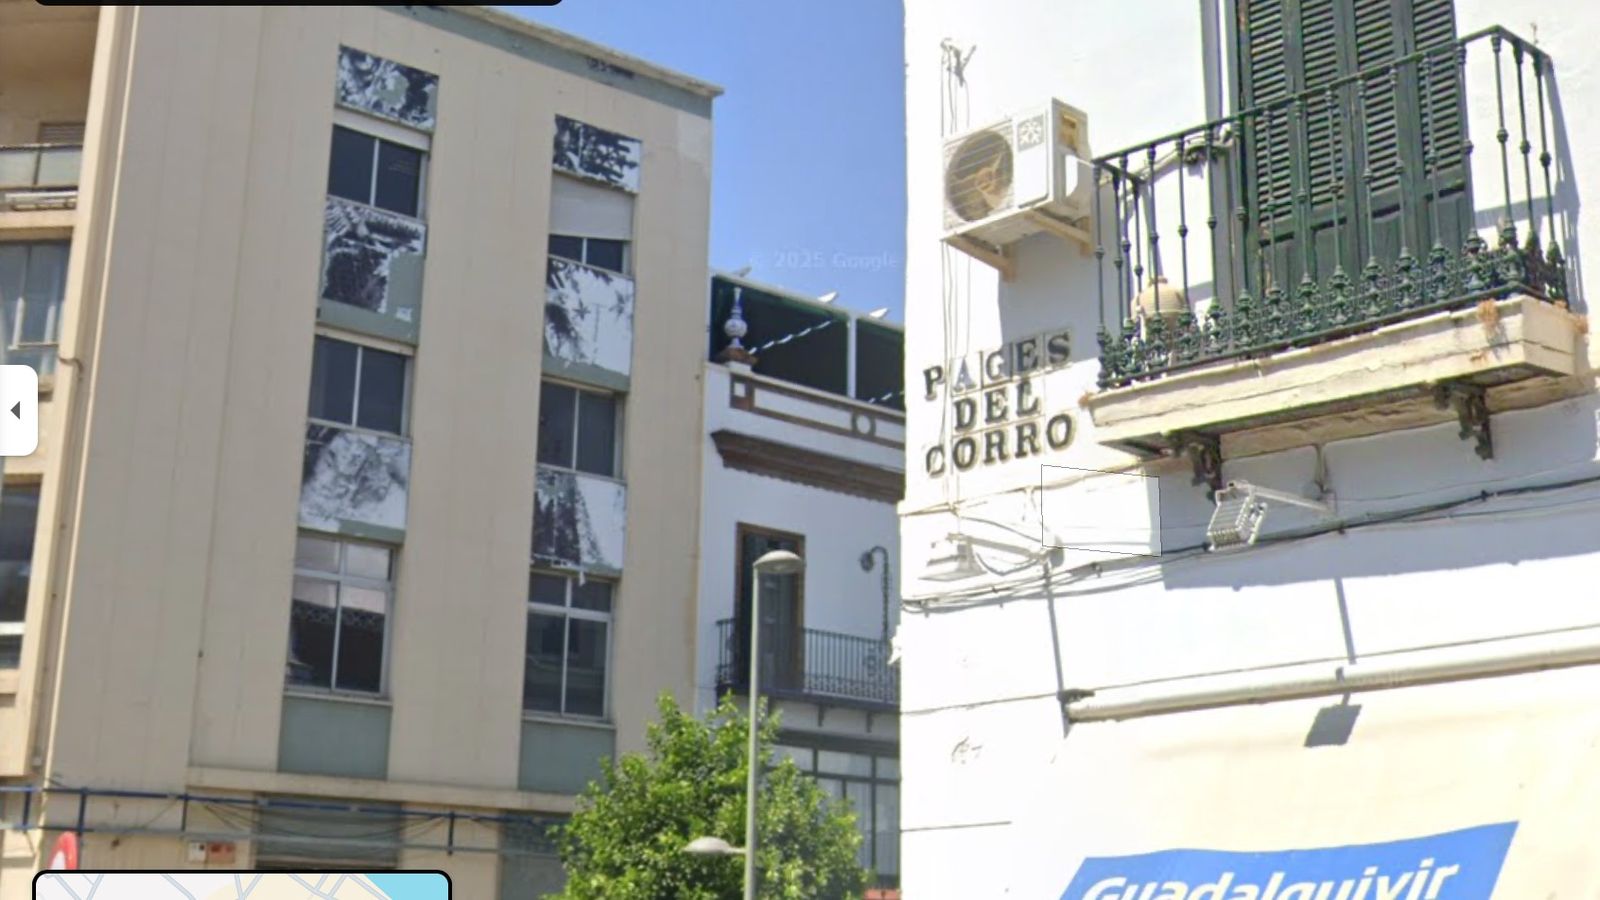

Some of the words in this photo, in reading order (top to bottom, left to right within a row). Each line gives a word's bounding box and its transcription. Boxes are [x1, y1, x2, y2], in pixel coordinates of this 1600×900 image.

[923, 332, 1071, 401] PAGES
[953, 378, 1040, 431] DEL
[925, 413, 1073, 478] CORRO
